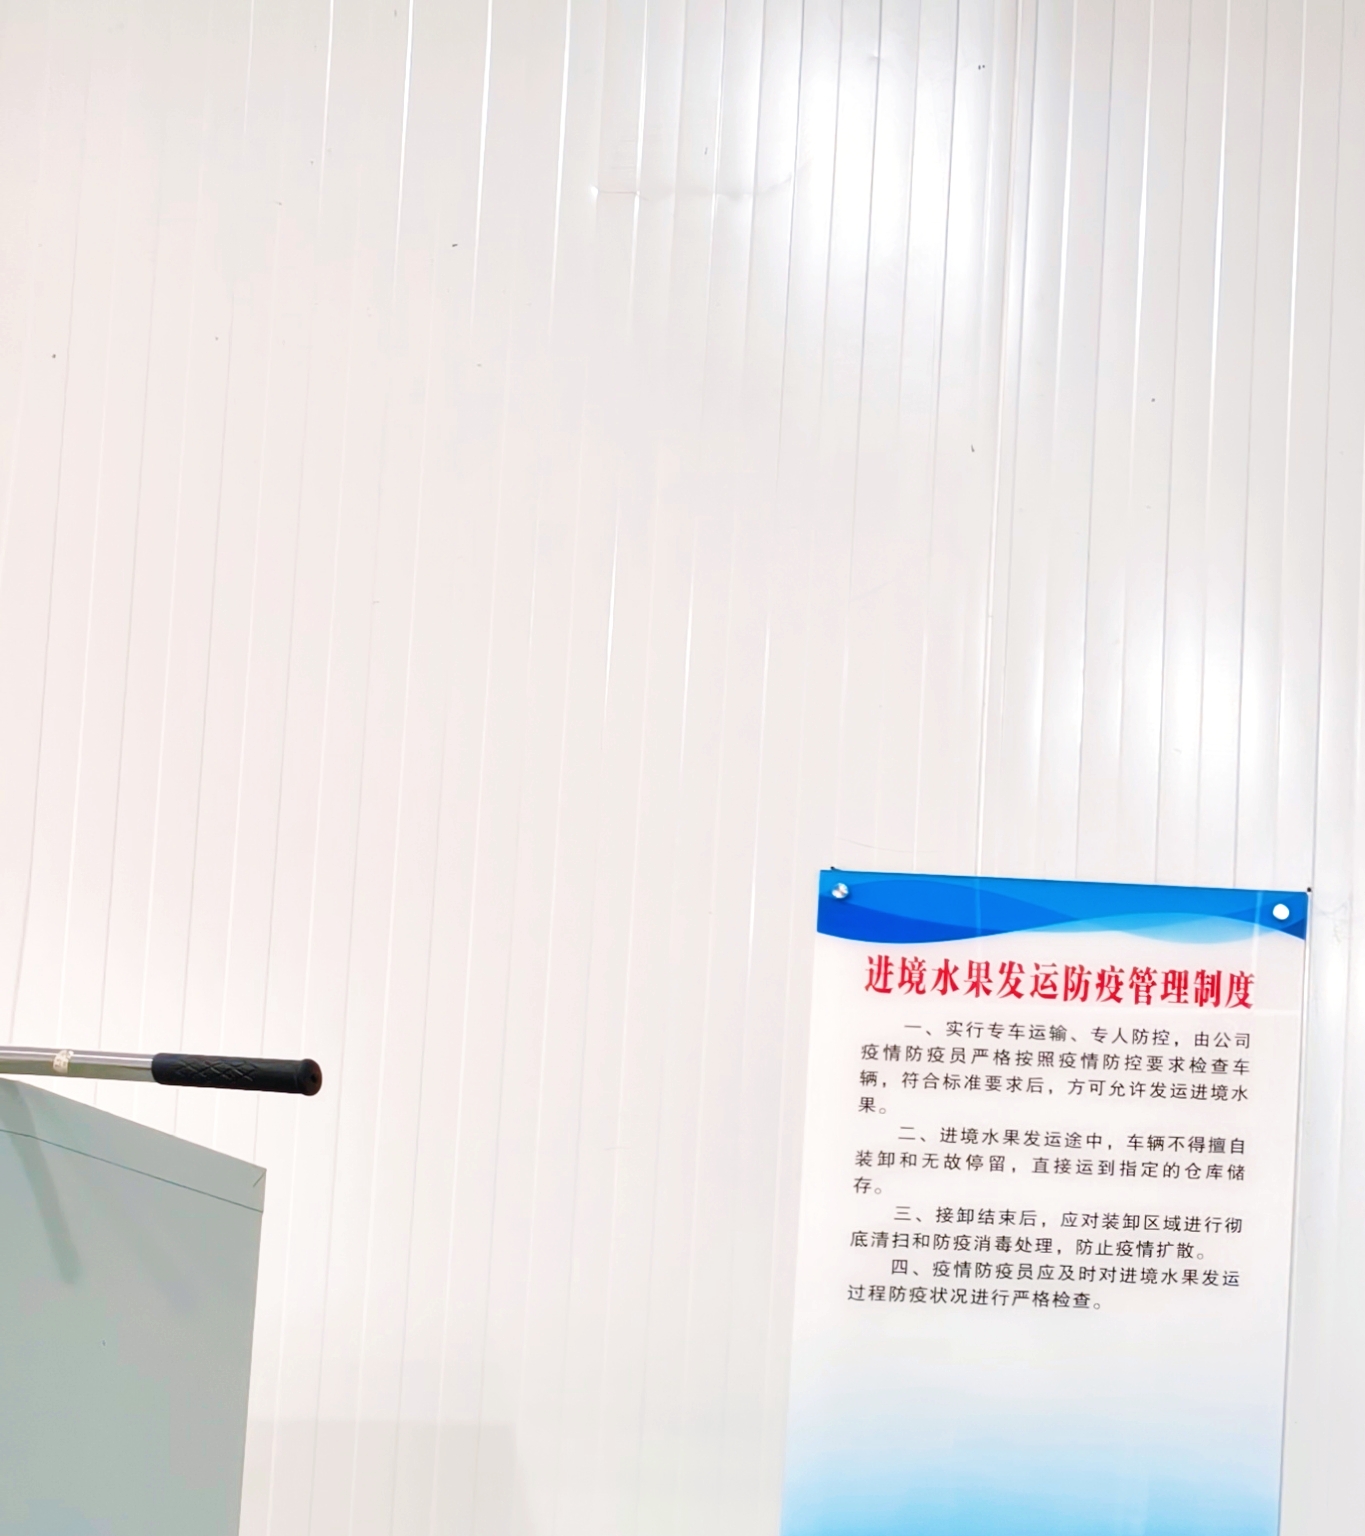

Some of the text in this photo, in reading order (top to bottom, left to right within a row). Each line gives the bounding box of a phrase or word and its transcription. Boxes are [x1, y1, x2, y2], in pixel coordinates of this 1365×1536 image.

[864, 955, 1254, 1009] 进境水果发运防疫管理制度
[904, 1021, 1250, 1049] 一、实行专车运输、专人防控，由公司
[861, 1044, 1250, 1075] 疫情防疫员严格按照疫情防控要求检查车
[859, 1070, 1248, 1102] 辆，符合标准要求后，方可允许发运进境水
[858, 1097, 886, 1114] 果。
[898, 1127, 1245, 1155] 二、进境水果发运途中，车辆不得擅自
[855, 1150, 1245, 1181] 装卸和无故停留，直接运到指定的仓库储
[853, 1176, 881, 1194] 存。
[894, 1206, 1242, 1233] 三、接卸结束后，应对装卸区域进行彻
[850, 1231, 1204, 1259] 底清扫和防疫消毒处理，防止疫情扩散。
[891, 1259, 1240, 1287] 四、疫情防疫员应及时对进境水果发运
[847, 1284, 1100, 1310] 过程防疫状况进行严格检查。
